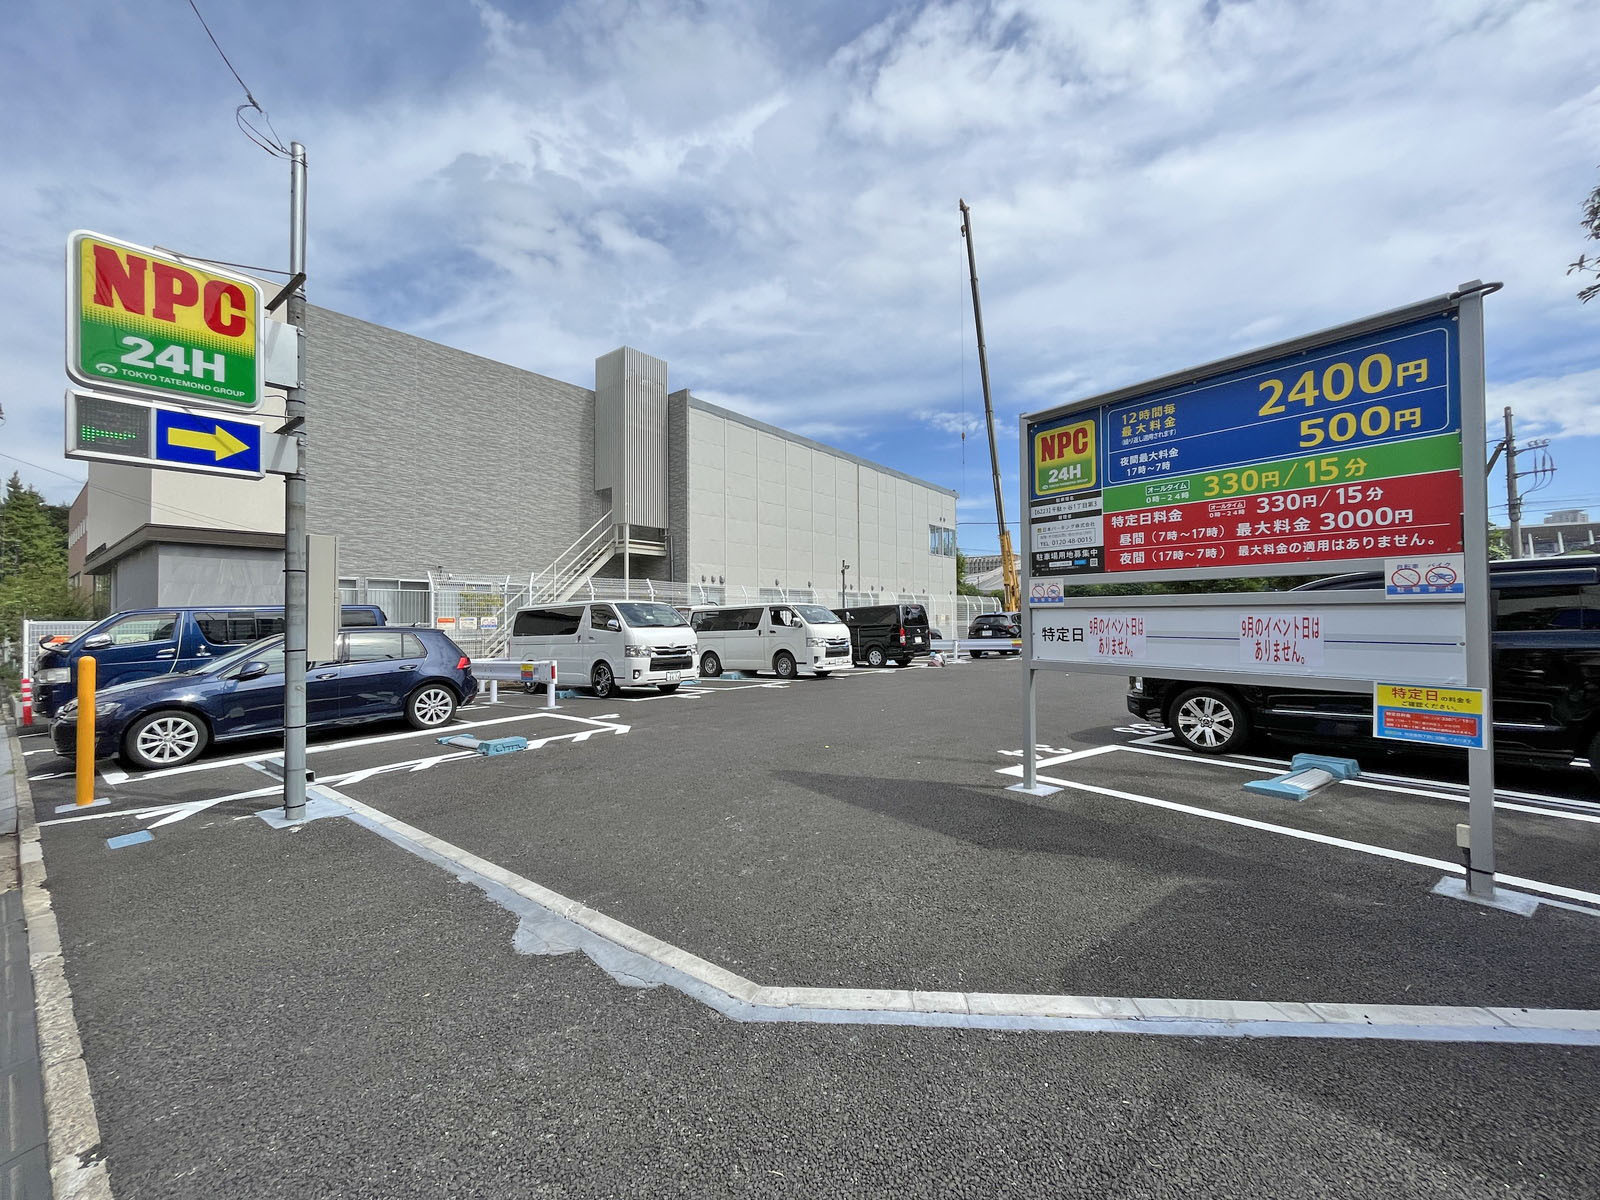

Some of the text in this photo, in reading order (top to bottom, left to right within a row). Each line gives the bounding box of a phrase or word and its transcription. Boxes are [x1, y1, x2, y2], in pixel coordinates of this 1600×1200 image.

[93, 244, 247, 338] NPC
[121, 336, 226, 383] 24H
[121, 368, 246, 398] TOKYO TATEMONO GROUP
[1258, 353, 1428, 416] 2400円
[1122, 403, 1176, 425] 12時間毎
[1121, 416, 1176, 437] 最大料金
[1300, 405, 1422, 448] 500円
[1041, 427, 1088, 462] NPC
[1120, 447, 1179, 467] 夜間最大料金
[1048, 463, 1082, 483] 24H
[1147, 482, 1188, 494] オールタイム
[1111, 508, 1183, 528] 特定日料金
[1210, 502, 1243, 511] オールタイム
[1236, 516, 1311, 537] 最大料金
[1320, 506, 1414, 531] 3000円
[1238, 532, 1436, 557] 最大料金の適用はありません。
[1042, 627, 1084, 642] 特定日
[1241, 616, 1320, 639] 9月のイベント日は
[1099, 638, 1134, 657] ありません。
[1255, 640, 1305, 664] ありません。
